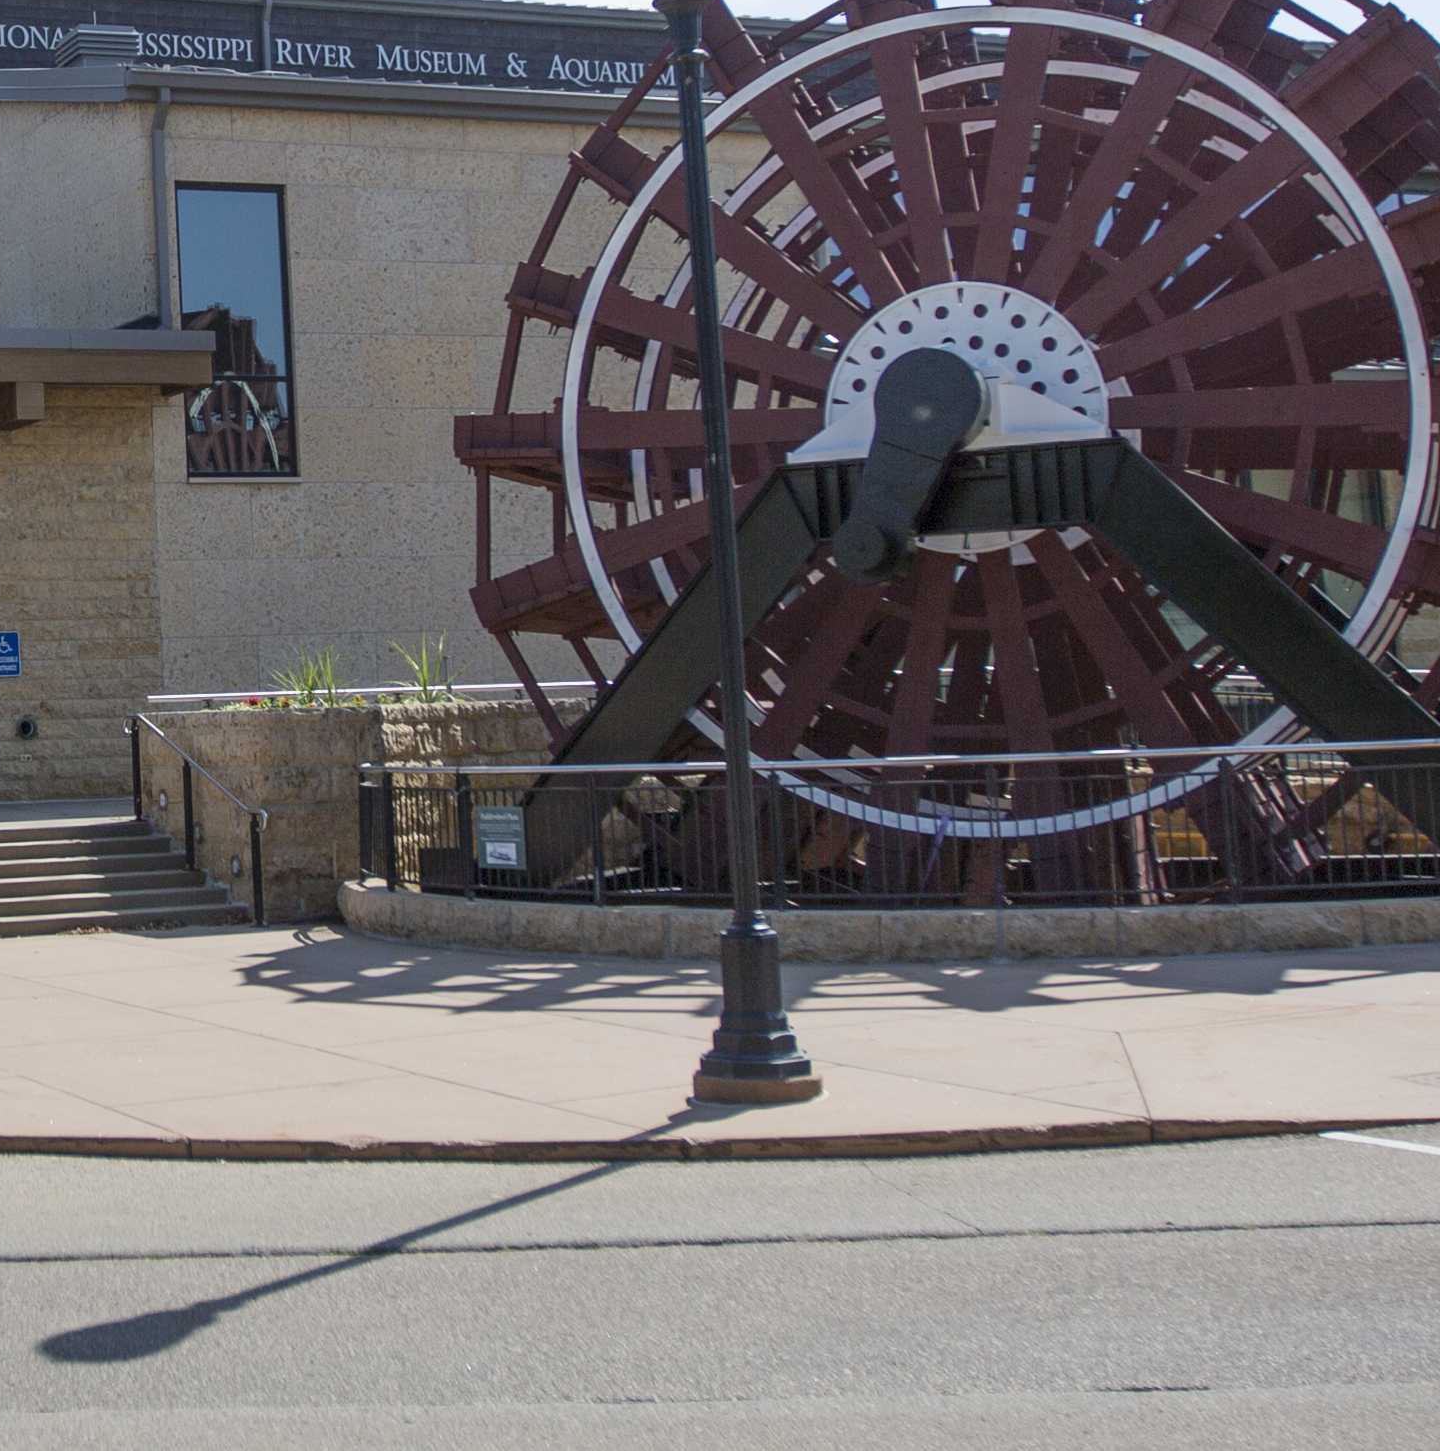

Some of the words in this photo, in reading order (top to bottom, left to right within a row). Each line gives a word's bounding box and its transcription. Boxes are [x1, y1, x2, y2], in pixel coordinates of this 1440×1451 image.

[136, 32, 254, 63] ISSISSIPPI
[275, 38, 355, 69] RIVER
[375, 44, 487, 76] MUSEUM
[507, 52, 528, 78] &
